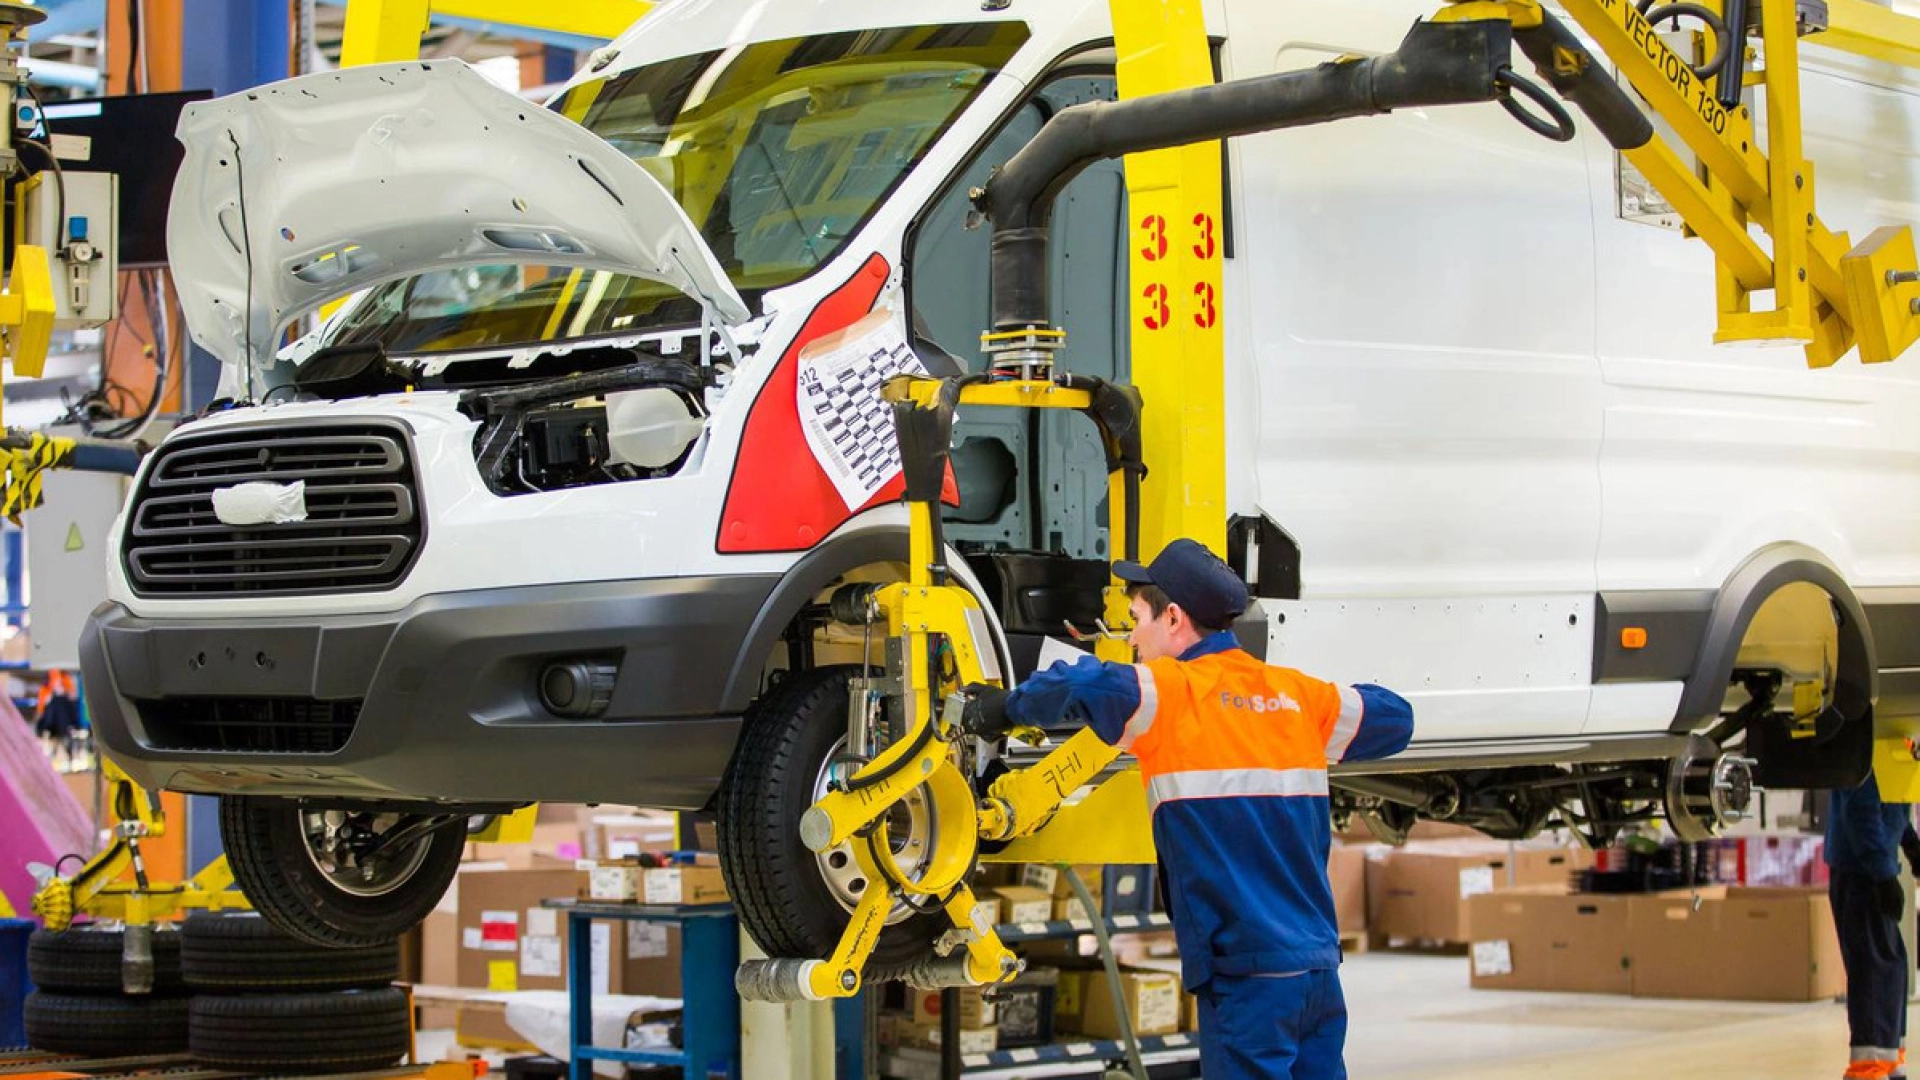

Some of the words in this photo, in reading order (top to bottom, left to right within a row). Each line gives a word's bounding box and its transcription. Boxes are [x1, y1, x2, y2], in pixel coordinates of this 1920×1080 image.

[1624, 2, 1690, 98] VECTOR
[1698, 91, 1725, 134] 130
[1141, 214, 1168, 261] 3
[1193, 213, 1215, 259] 3
[1143, 283, 1170, 330] 3
[1194, 282, 1216, 329] 3
